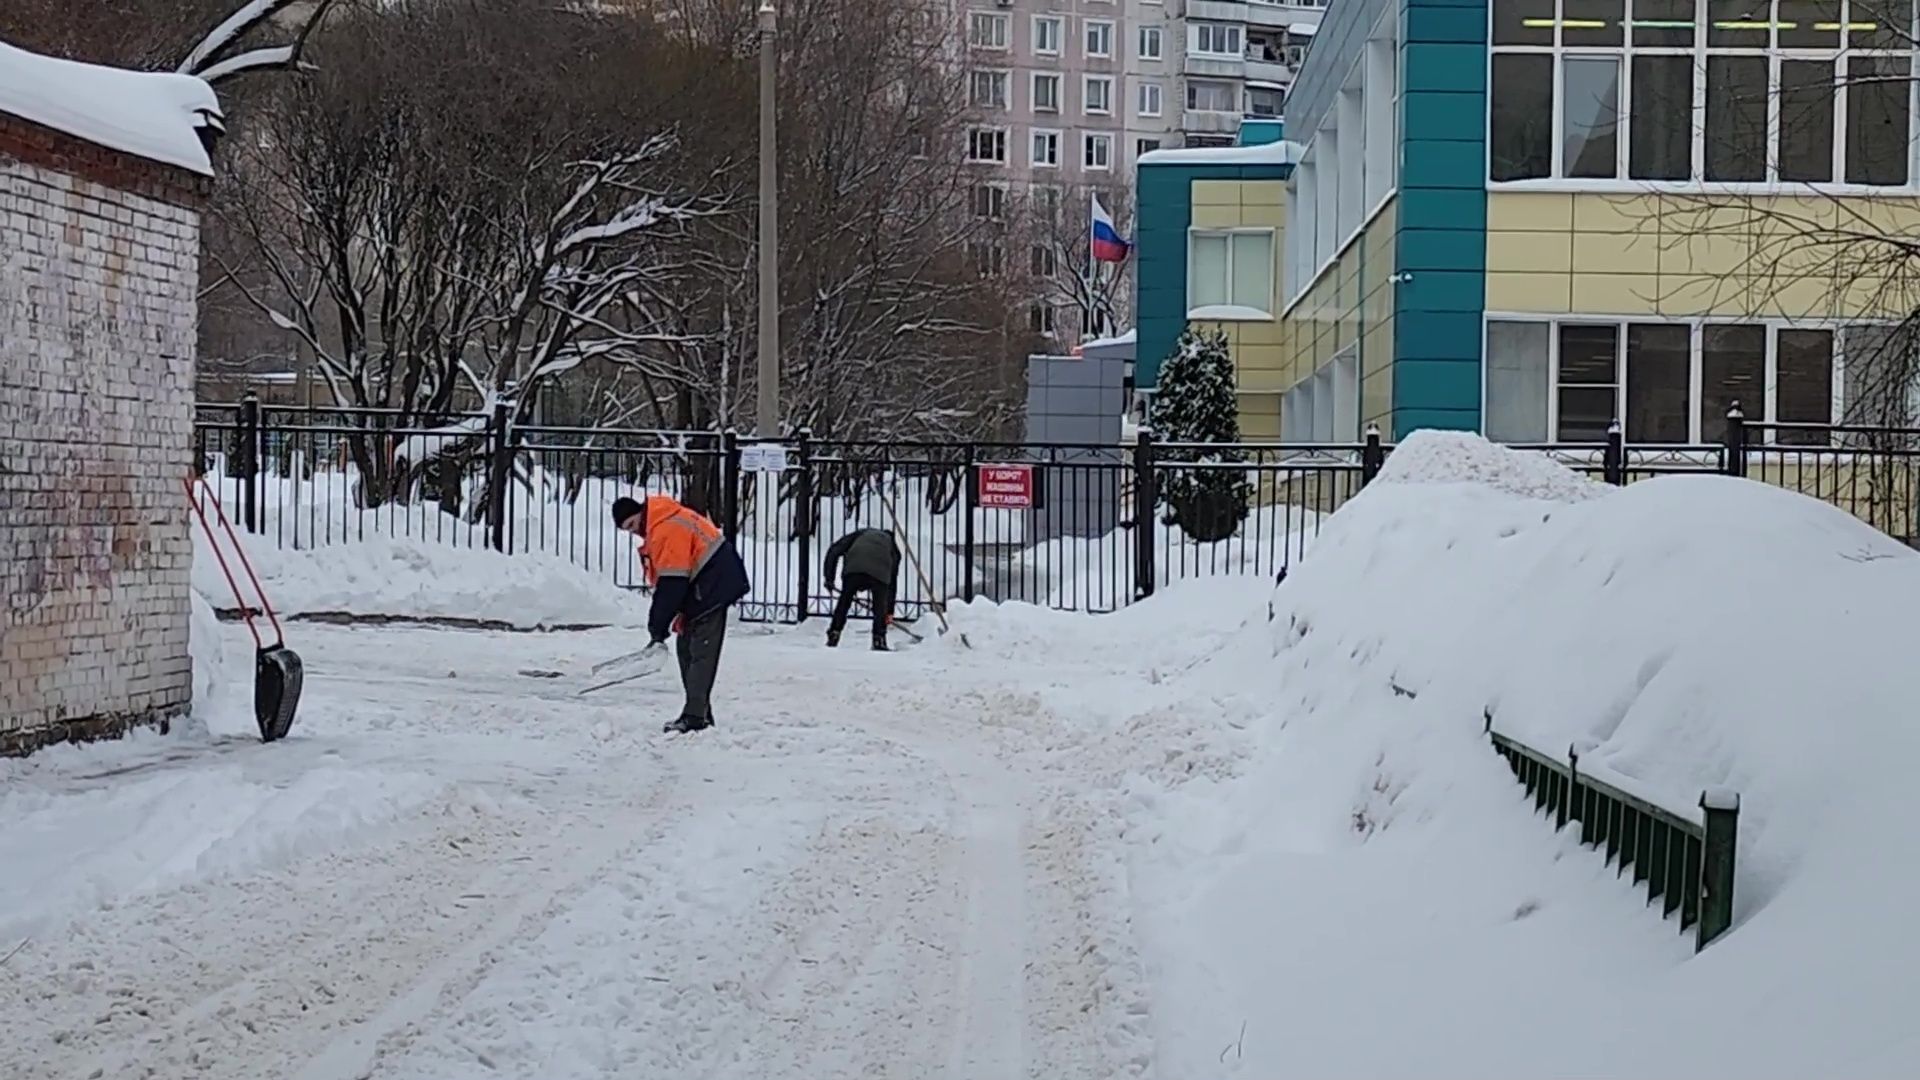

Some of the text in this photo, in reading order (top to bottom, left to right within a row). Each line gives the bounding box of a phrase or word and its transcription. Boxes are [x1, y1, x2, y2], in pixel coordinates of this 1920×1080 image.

[988, 470, 1023, 481] У ВОРОТ
[985, 482, 1025, 492] МАШИНЫ
[982, 494, 1029, 505] НЕ СТАВИТЬ
